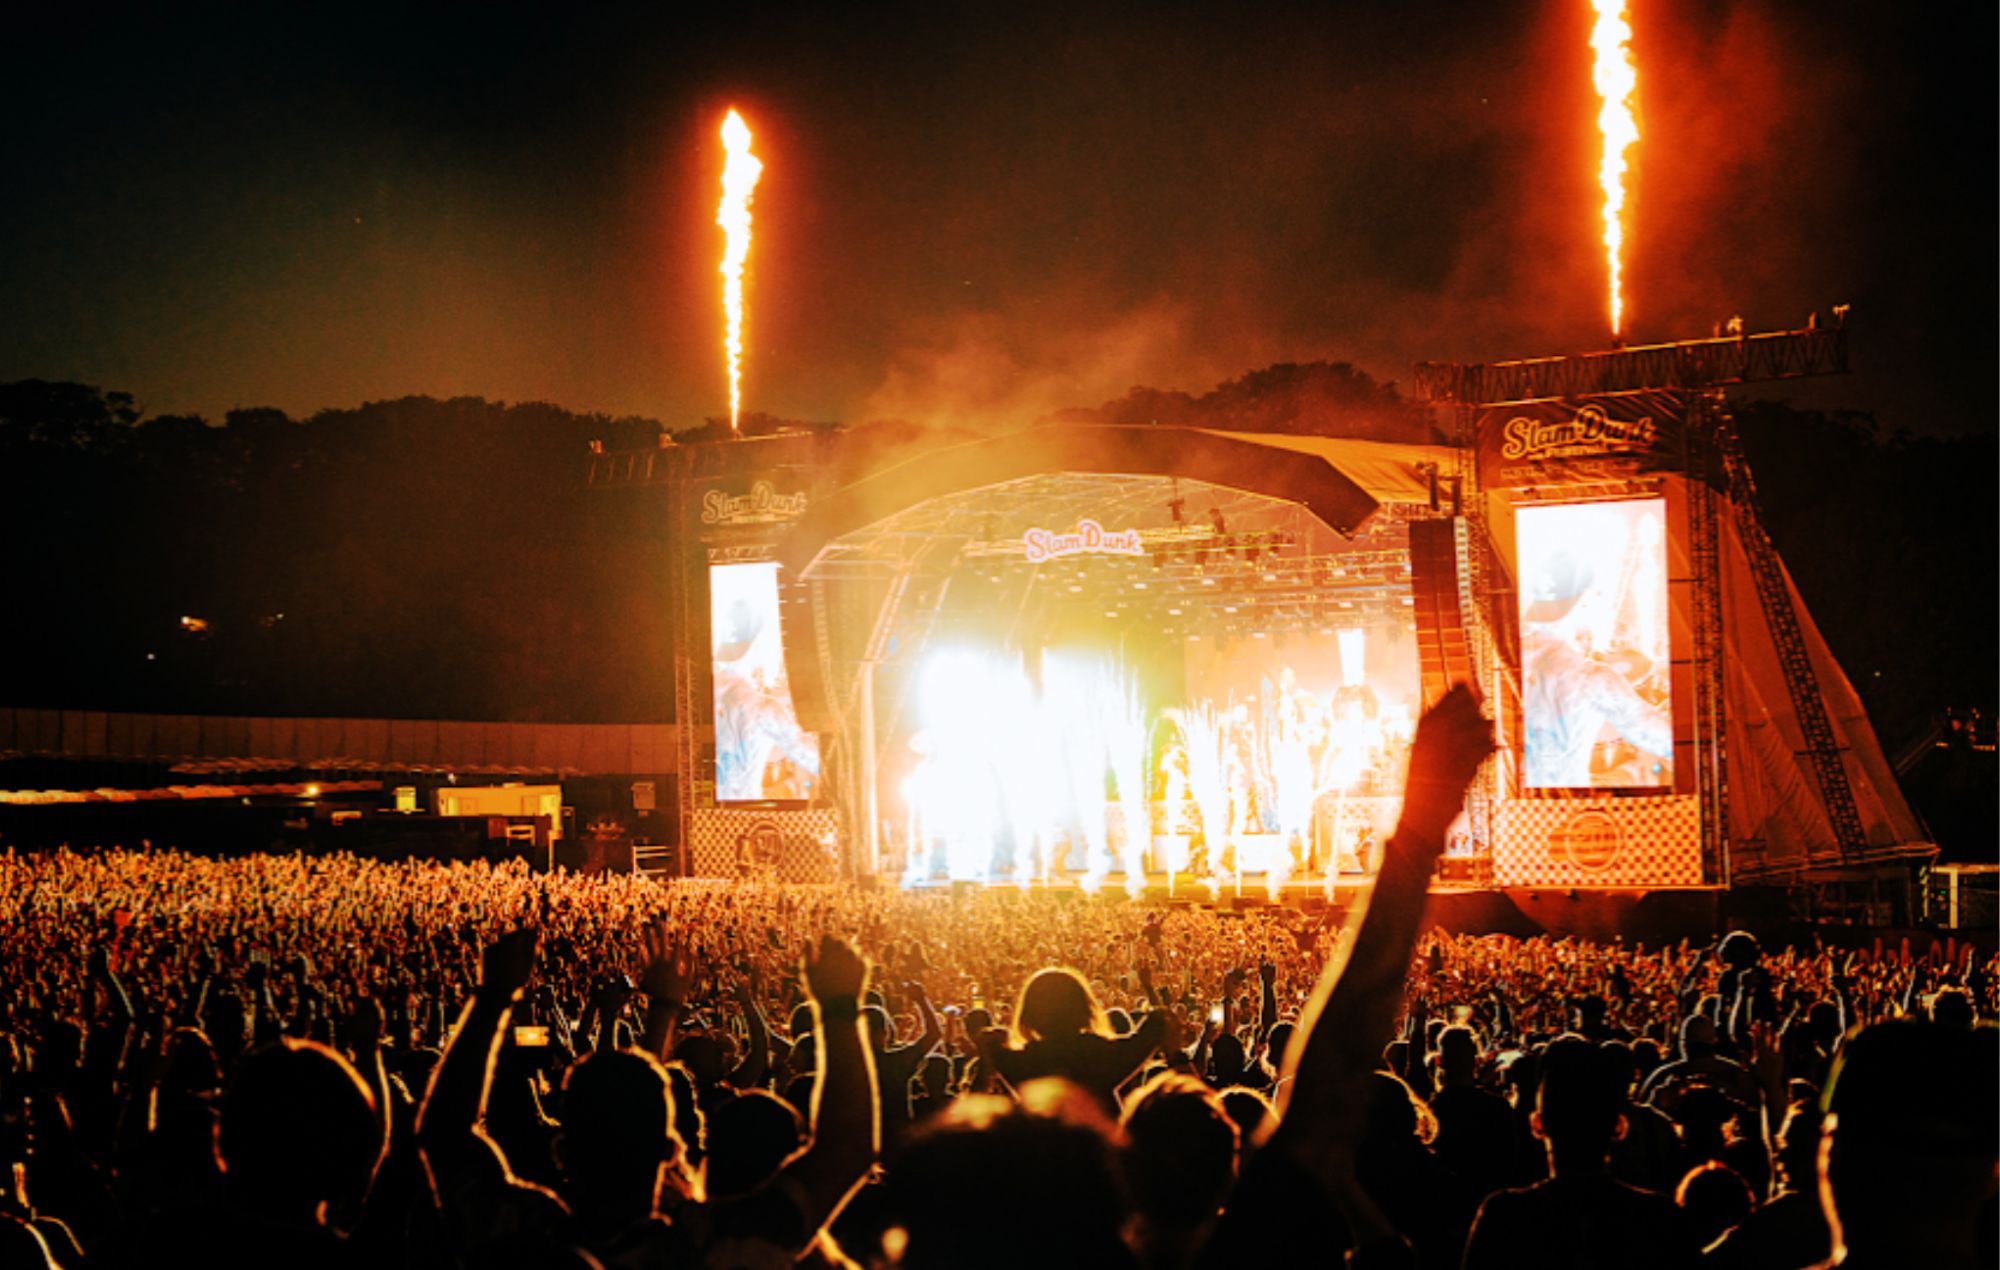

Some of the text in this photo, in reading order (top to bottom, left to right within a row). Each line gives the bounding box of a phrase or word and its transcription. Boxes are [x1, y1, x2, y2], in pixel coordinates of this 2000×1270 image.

[1503, 405, 1657, 459] Slam Dunk
[702, 481, 807, 523] Slam Dunk
[1025, 520, 1143, 562] Slam Dunk
